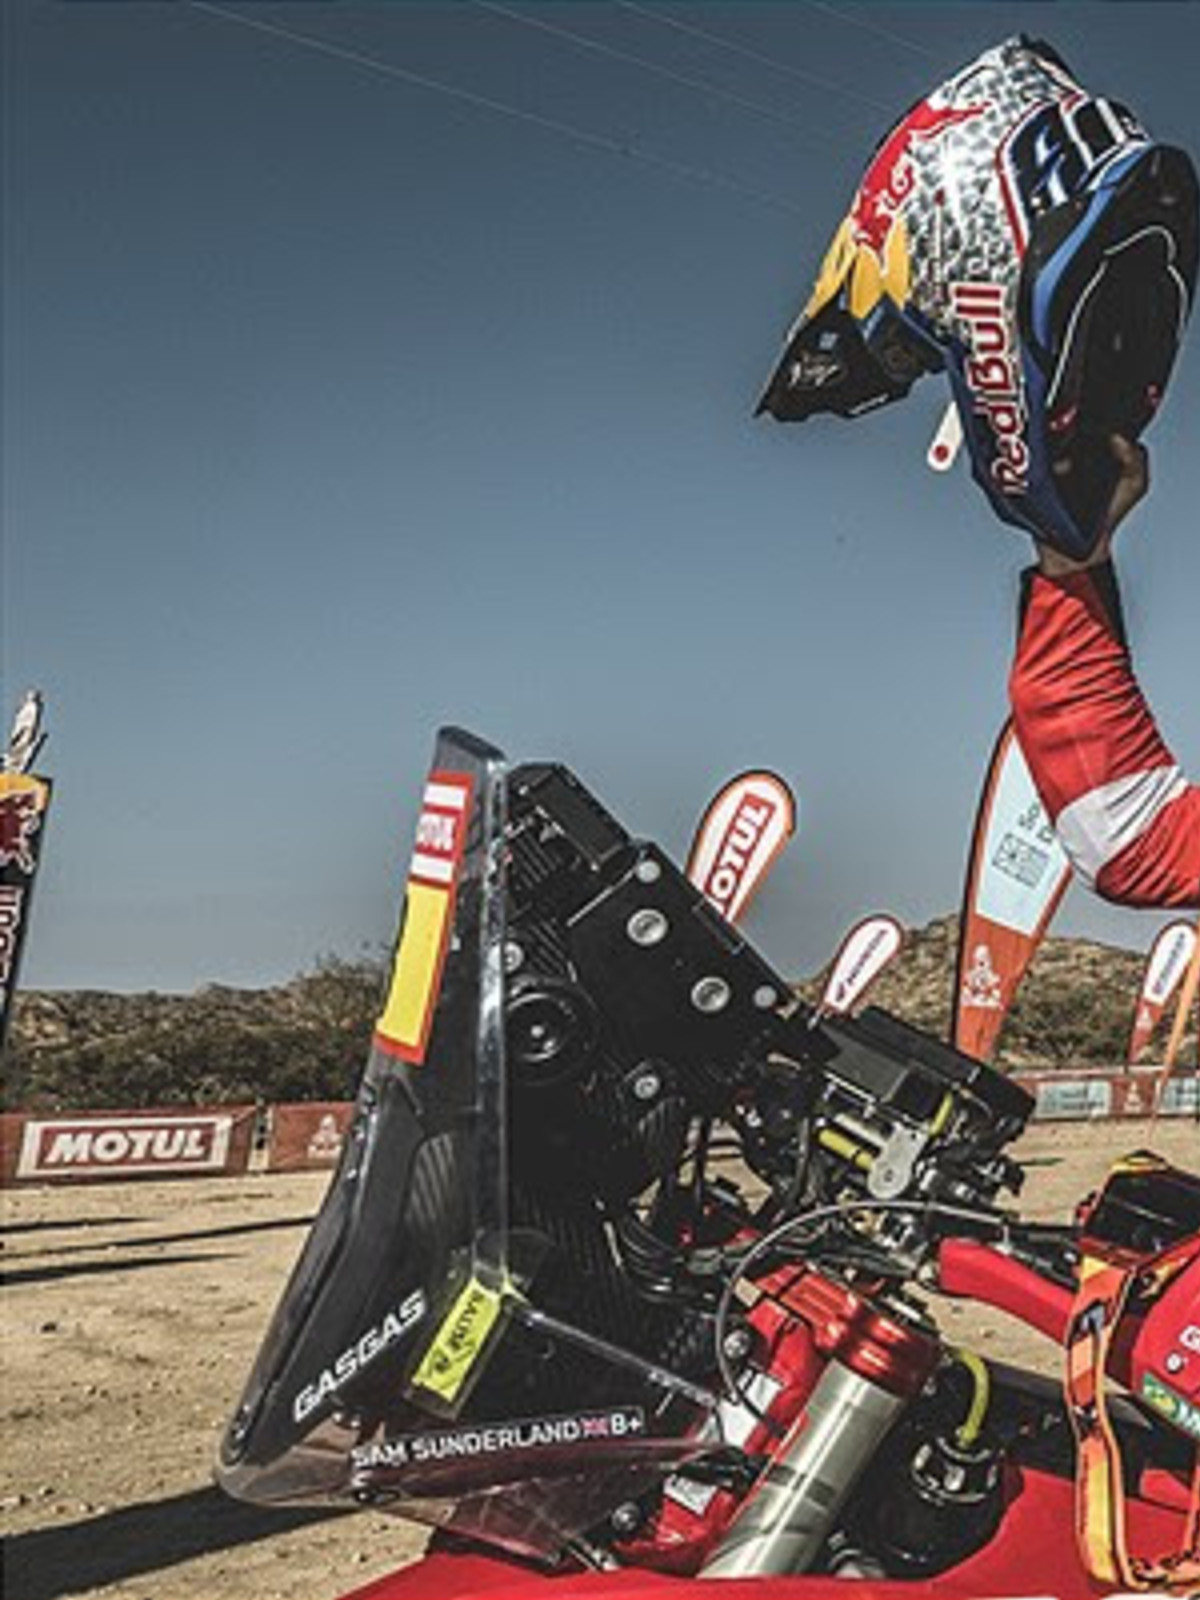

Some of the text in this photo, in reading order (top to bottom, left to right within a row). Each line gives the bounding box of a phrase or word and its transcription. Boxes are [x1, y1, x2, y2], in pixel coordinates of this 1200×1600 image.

[950, 282, 1029, 495] Red Bull
[44, 1128, 205, 1164] MOTUL
[294, 1288, 426, 1423] GASGAS
[351, 1412, 642, 1468] SAM SUNDERLAND B+
